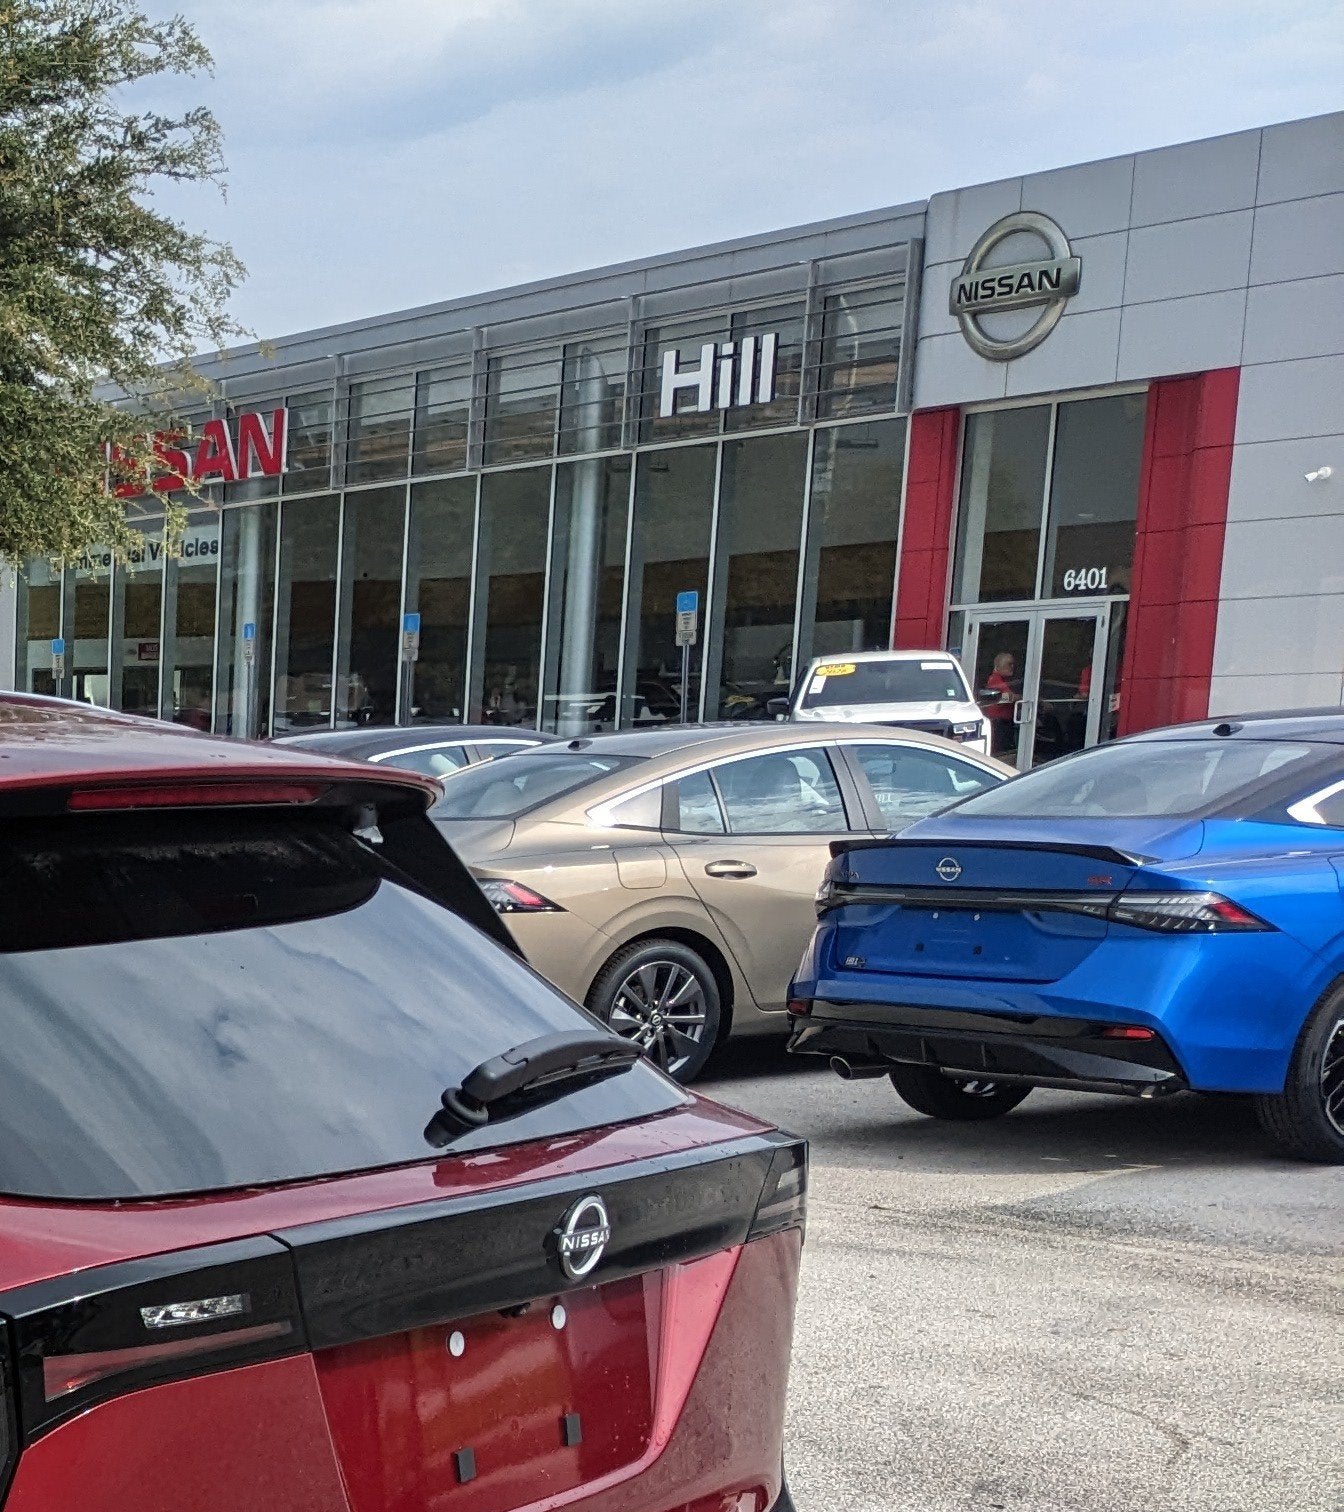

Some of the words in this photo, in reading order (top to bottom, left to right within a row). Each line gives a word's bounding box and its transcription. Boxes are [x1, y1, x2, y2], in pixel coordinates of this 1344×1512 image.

[956, 267, 1062, 304] NISSAN
[659, 332, 779, 418] Hill
[149, 536, 220, 562] Vicles
[1063, 566, 1108, 591] 6401
[562, 1229, 611, 1251] NISSAN
